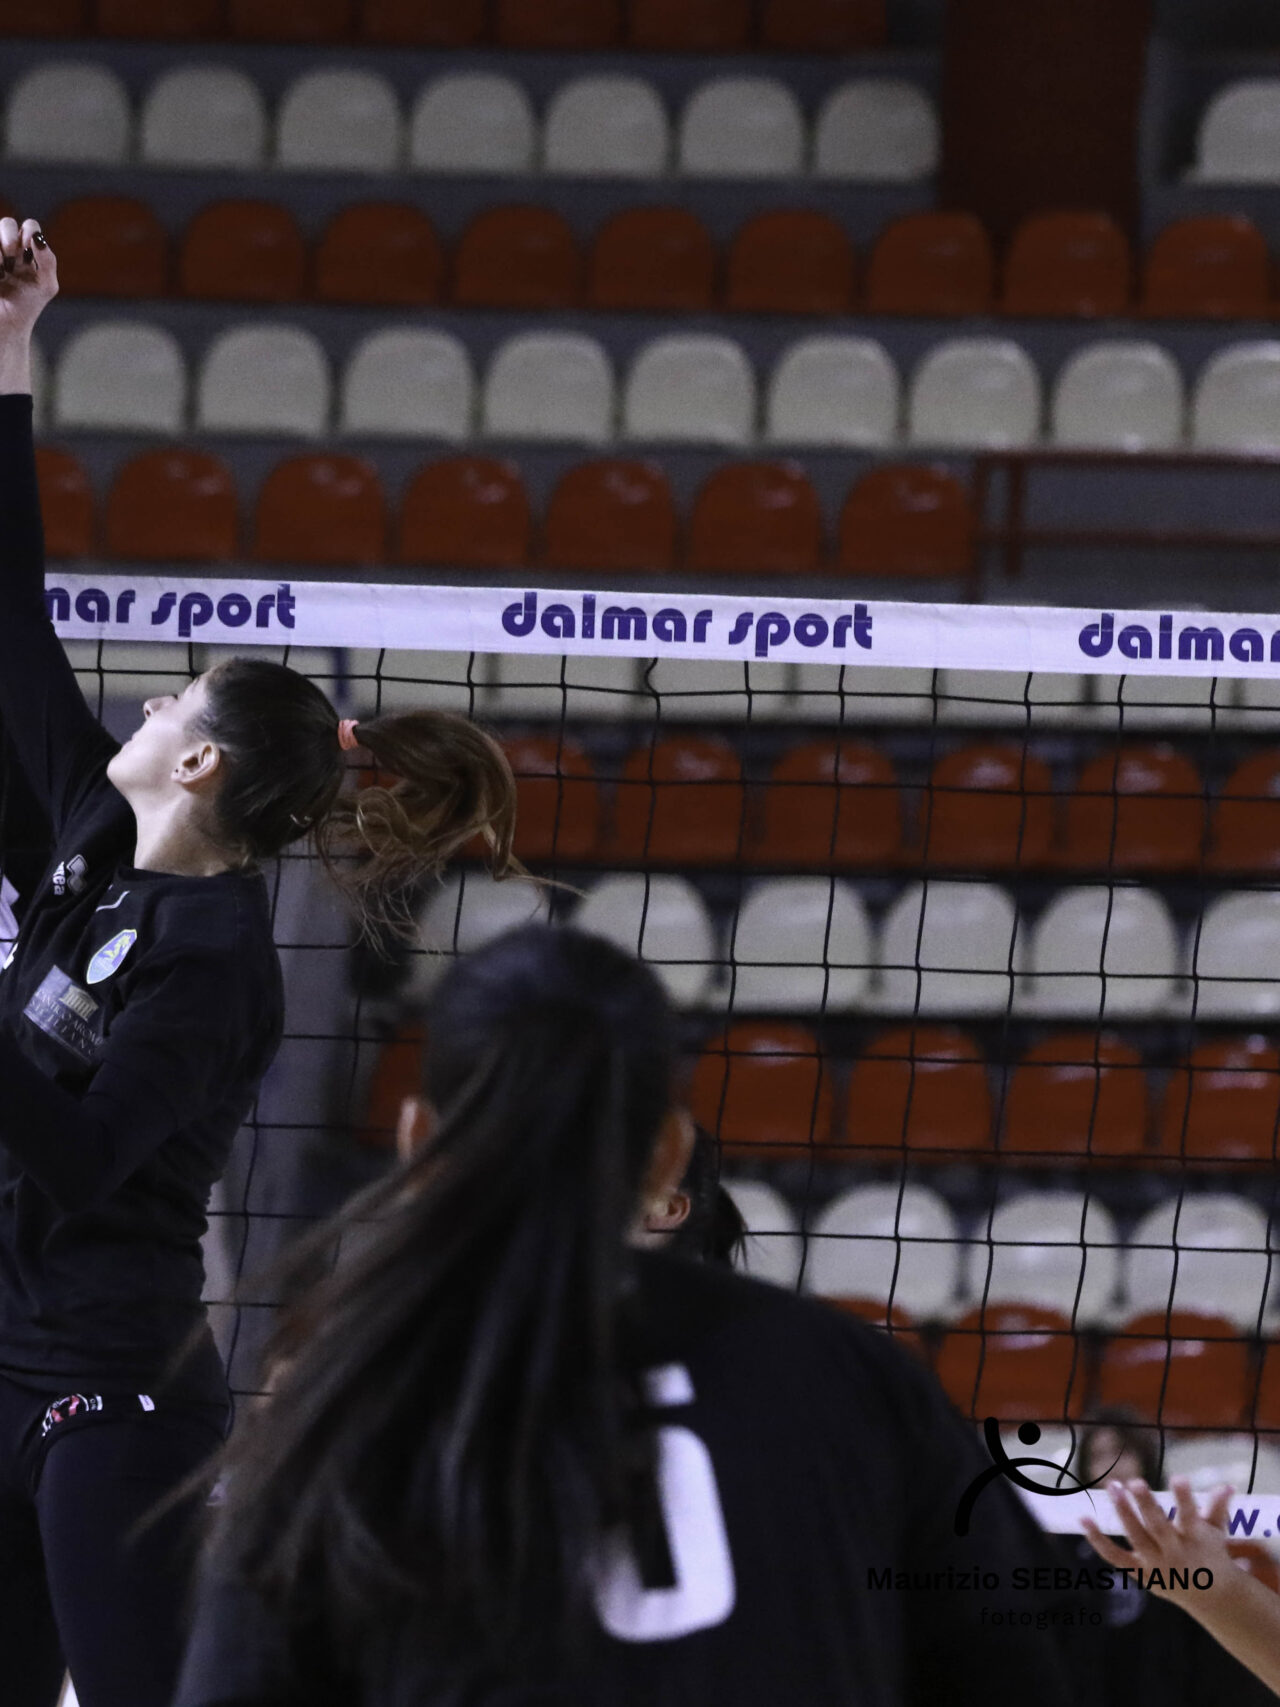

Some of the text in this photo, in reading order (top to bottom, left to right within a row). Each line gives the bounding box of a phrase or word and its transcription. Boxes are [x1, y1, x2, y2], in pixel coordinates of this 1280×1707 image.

[151, 584, 296, 638] sport
[502, 592, 873, 658] dalmar sport
